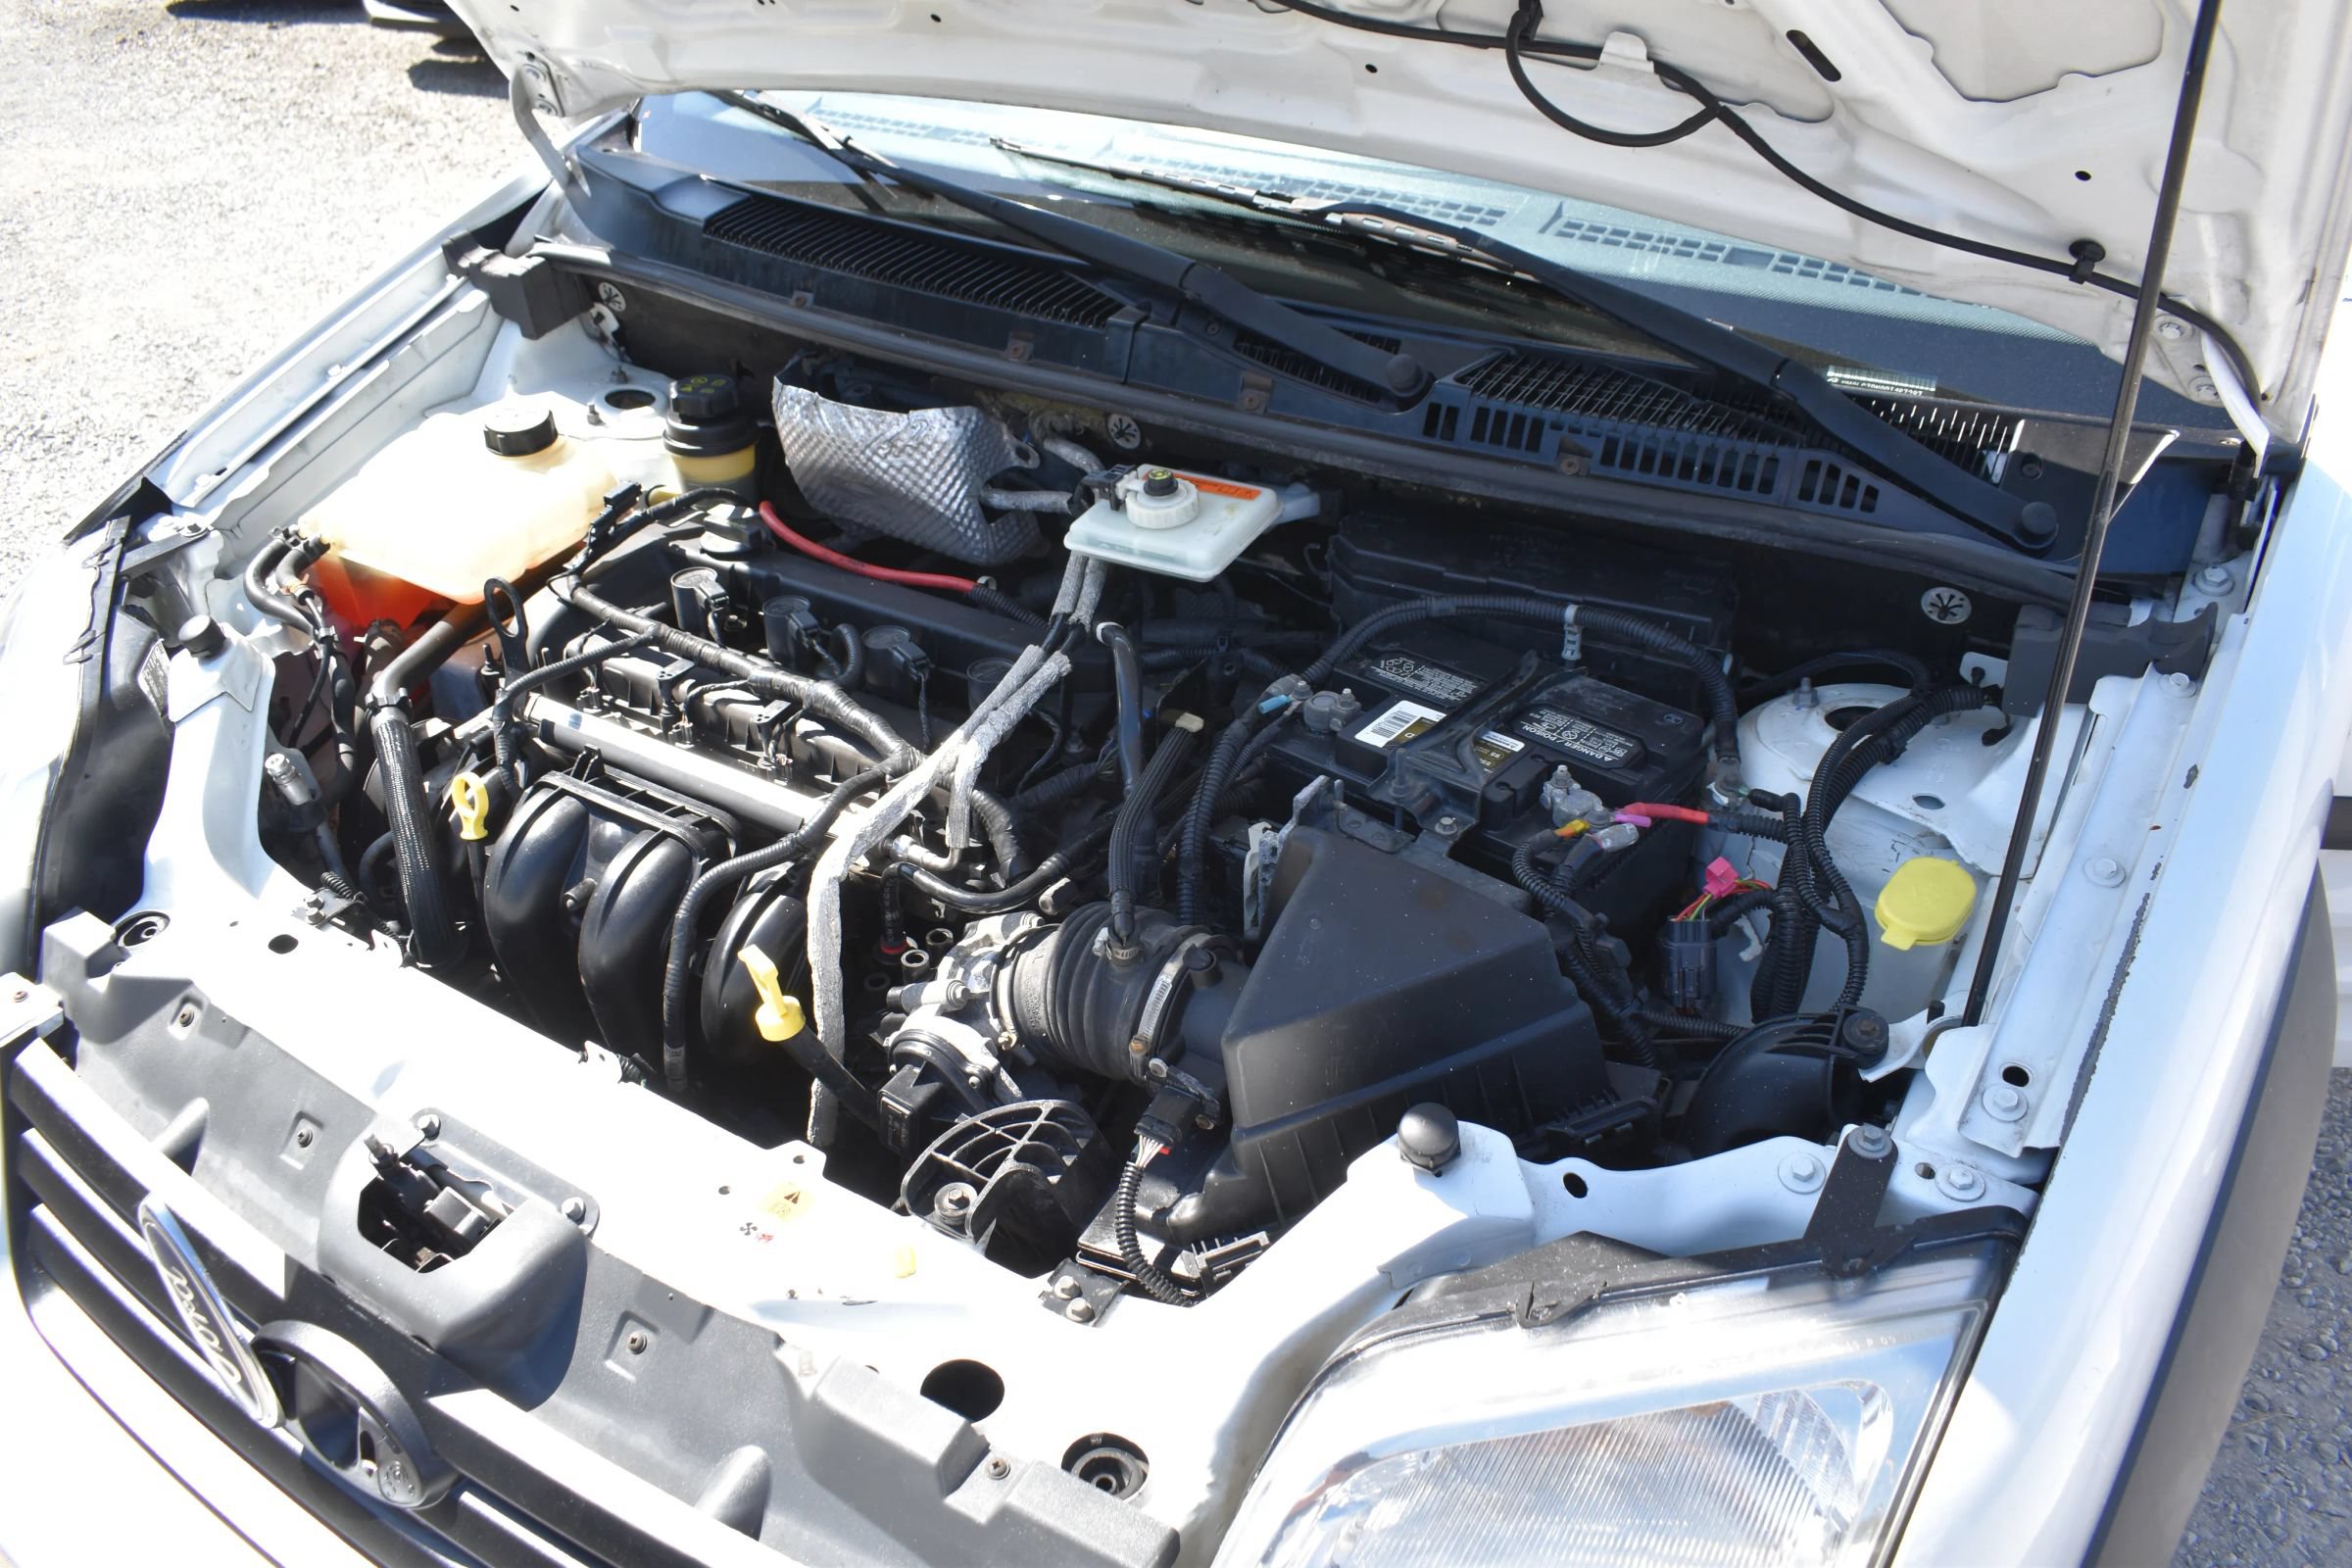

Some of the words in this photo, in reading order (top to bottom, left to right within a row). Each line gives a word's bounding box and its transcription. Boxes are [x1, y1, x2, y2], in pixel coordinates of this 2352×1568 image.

[1522, 725, 1557, 742] POISON
[1564, 741, 1603, 760] DANGER
[169, 1266, 242, 1384] Ford
